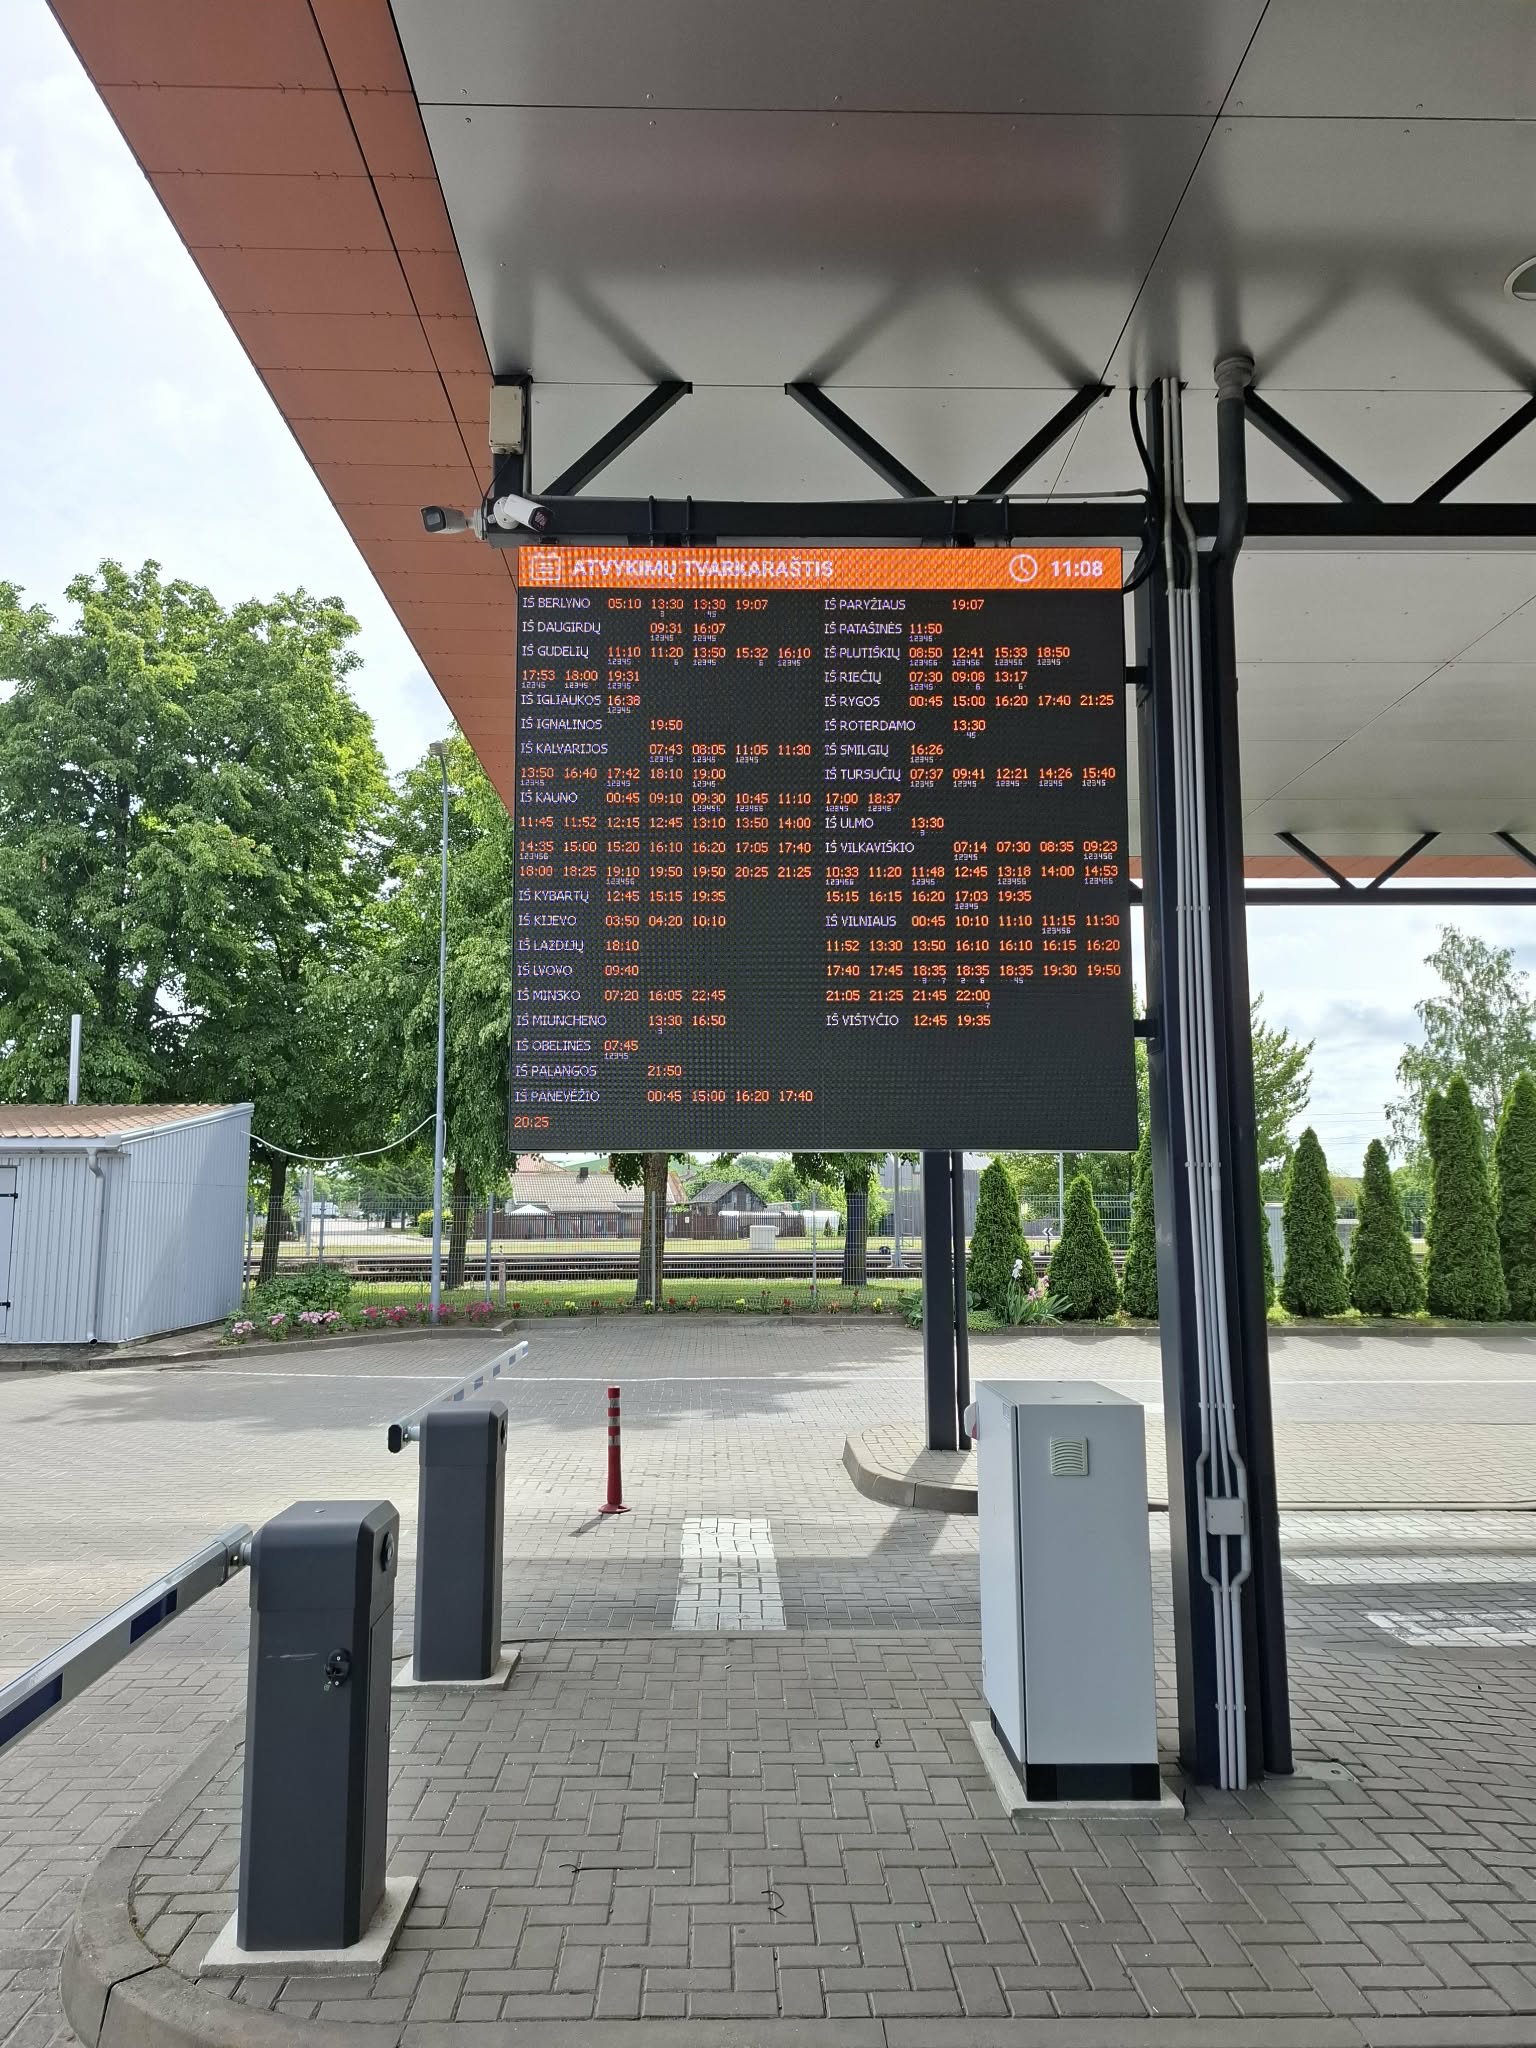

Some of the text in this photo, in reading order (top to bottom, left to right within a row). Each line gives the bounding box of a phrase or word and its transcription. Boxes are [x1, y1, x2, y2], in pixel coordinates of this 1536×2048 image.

[572, 557, 833, 579] ATVYKIMŲ TVARKARAŠTIS
[1050, 560, 1103, 577] 11:08
[523, 596, 535, 610] IŠ
[608, 599, 642, 610] 05:10
[651, 599, 684, 610] 13:30
[693, 599, 727, 610] 13:30
[736, 599, 770, 610] 19:07
[825, 596, 837, 610] IŠ
[952, 599, 986, 610] 19:07
[522, 620, 534, 634] IŠ
[650, 623, 684, 634] 09:31
[693, 623, 727, 634] 16:07
[825, 621, 837, 635] IŠ
[909, 624, 943, 635] 11:50
[522, 644, 534, 658] IŠ
[607, 647, 641, 658] 11:10
[650, 647, 684, 658] 11:20
[693, 647, 727, 658] 13:50
[736, 647, 770, 658] 15:32
[779, 647, 813, 658] 16:10
[825, 644, 837, 658] IŠ
[909, 647, 943, 658] 08:50
[952, 647, 986, 658] 12:41
[994, 647, 1028, 658] 15:33
[1037, 647, 1071, 658] 18:50
[825, 668, 837, 682] IŠ
[909, 671, 943, 682] 07:30
[952, 671, 986, 682] 09:08
[995, 671, 1028, 682] 13:17
[522, 692, 534, 706] IŠ
[607, 695, 641, 706] 16:38
[825, 693, 837, 707] IŠ
[910, 696, 943, 707] 00:45
[952, 696, 986, 707] 15:00
[995, 696, 1028, 707] 16:20
[1037, 696, 1071, 707] 17:40
[1080, 696, 1114, 707] 21:25
[521, 717, 533, 731] IŠ
[650, 720, 684, 731] 19:50
[825, 717, 837, 731] IŠ
[952, 720, 986, 731] 13:30
[521, 741, 533, 755] IŠ
[650, 744, 683, 755] 07:43
[693, 744, 726, 755] 08:05
[736, 744, 770, 755] 11:05
[779, 744, 813, 755] 11:30
[825, 741, 837, 755] IŠ
[910, 744, 944, 755] 16:26
[825, 765, 837, 779] IŠ
[910, 768, 944, 779] 07:37
[953, 768, 987, 779] 09:41
[996, 768, 1030, 779] 12:21
[1039, 768, 1073, 779] 14:26
[1082, 768, 1115, 779] 15:40
[520, 790, 532, 804] IŠ
[606, 793, 640, 804] 00:45
[649, 793, 683, 804] 09:10
[692, 793, 726, 804] 09:30
[736, 793, 769, 804] 10:45
[779, 793, 813, 804] 11:10
[825, 793, 902, 804] 17:00 18:37
[826, 814, 838, 828] IŠ
[911, 817, 945, 828] 13:30
[826, 838, 838, 852] IŠ
[954, 841, 988, 852] 07:14
[997, 841, 1031, 852] 07:30
[1040, 841, 1074, 852] 08:35
[1083, 841, 1117, 852] 09:23
[519, 888, 531, 902] IŠ
[605, 891, 639, 902] 12:45
[649, 891, 682, 902] 15:15
[692, 891, 726, 902] 19:35
[518, 913, 530, 927] IŠ
[605, 916, 639, 927] 03:50
[648, 916, 682, 927] 04:20
[692, 916, 726, 927] 10:10
[826, 913, 838, 927] IŠ
[912, 916, 946, 927] 00:45
[956, 916, 989, 927] 10:10
[999, 916, 1033, 927] 11:10
[1042, 916, 1076, 927] 11:15
[1085, 916, 1119, 927] 11:30
[518, 938, 530, 952] IŠ
[605, 941, 638, 952] 18:10
[518, 962, 530, 976] IŠ
[604, 965, 638, 976] 09:40
[517, 987, 529, 1001] IŠ
[604, 990, 638, 1001] 07:20
[648, 990, 682, 1001] 16:05
[691, 990, 725, 1001] 22:45
[517, 1012, 529, 1026] IŠ
[647, 1015, 681, 1026] 13:30
[691, 1015, 725, 1026] 16:50
[827, 1012, 839, 1026] IŠ
[913, 1015, 947, 1026] 12:45
[957, 1015, 991, 1026] 19:35
[516, 1037, 528, 1051] IŠ
[603, 1040, 637, 1051] 07:45
[516, 1062, 528, 1076] IŠ
[647, 1065, 681, 1076] 21:50
[515, 1088, 527, 1102] IŠ
[647, 1091, 680, 1102] 00:45
[691, 1091, 725, 1102] 15:00
[735, 1091, 769, 1102] 16:20
[779, 1091, 813, 1102] 17:40
[514, 1117, 548, 1128] 20:25
